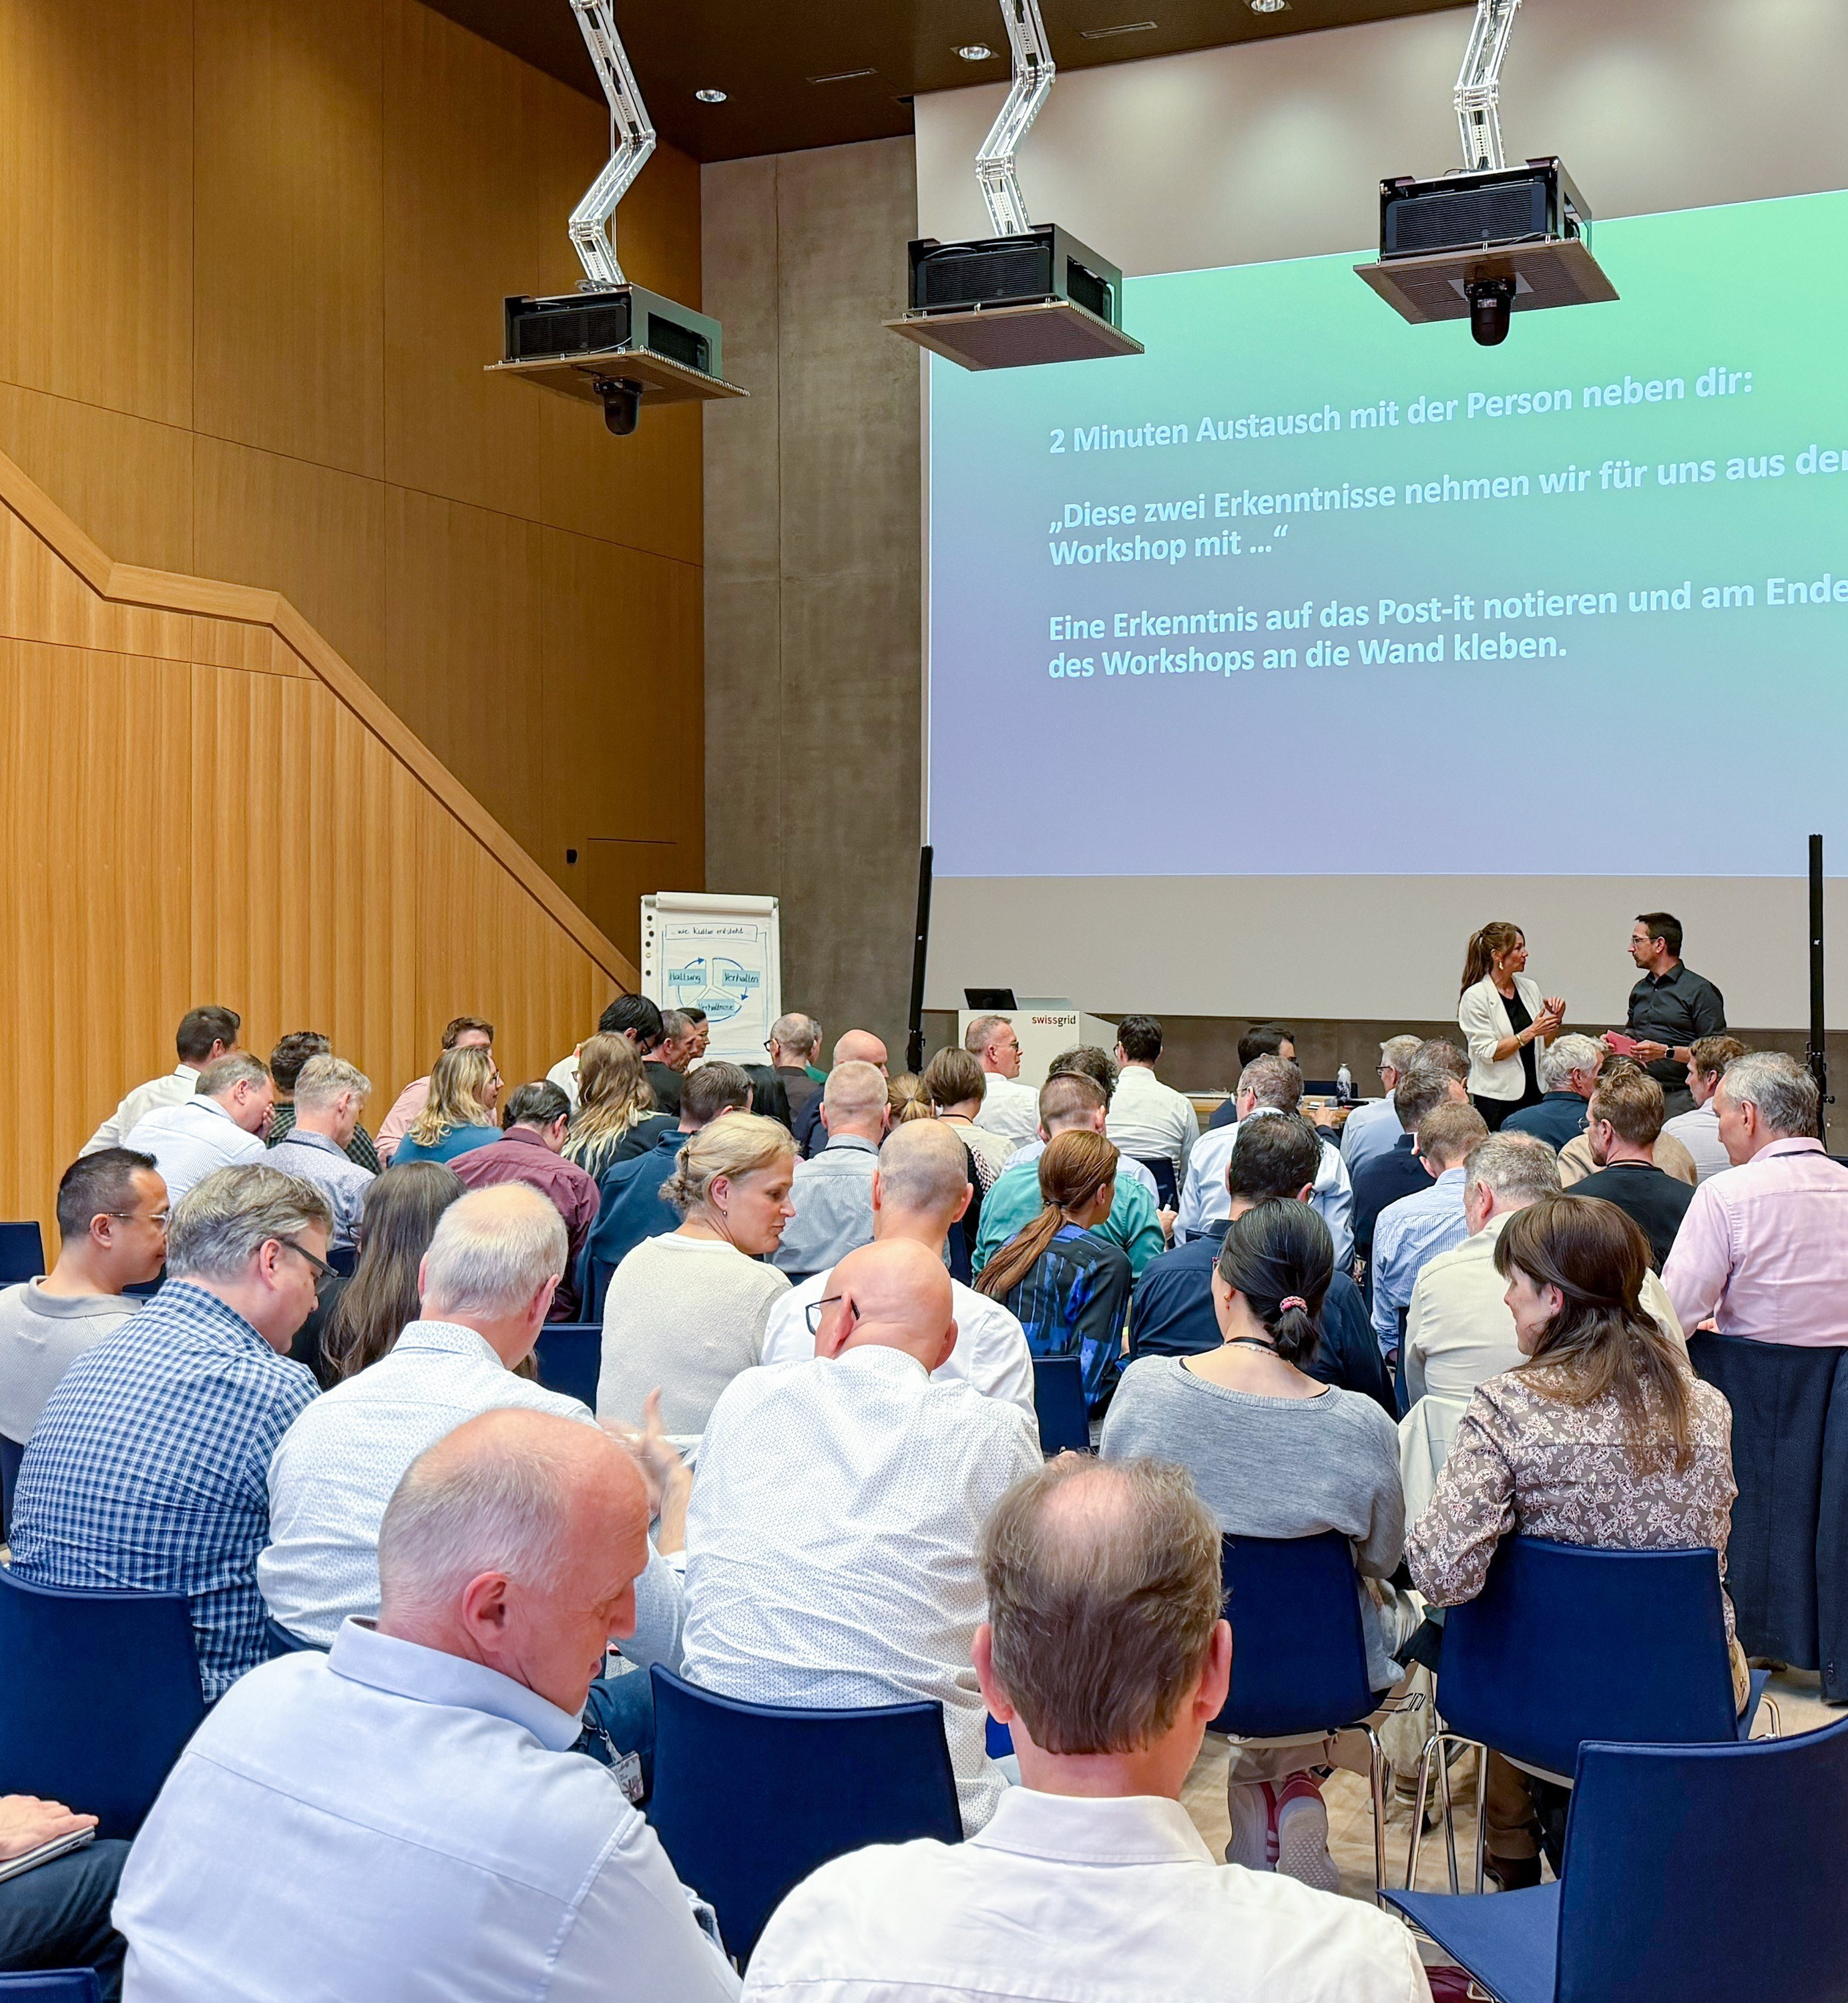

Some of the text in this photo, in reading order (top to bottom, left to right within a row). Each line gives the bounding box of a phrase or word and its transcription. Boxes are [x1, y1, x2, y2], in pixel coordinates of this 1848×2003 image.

[1050, 366, 1753, 454] 2 Minuten Austausch mit der Person neben dir:
[1144, 493, 1206, 523] zwei
[1214, 482, 1396, 517] Erkenntnisse
[1405, 474, 1530, 505] nehmen
[1538, 464, 1592, 494] wir
[1598, 459, 1648, 490] für
[1657, 460, 1716, 485] uns
[1725, 454, 1786, 480] aus
[1049, 534, 1186, 566] Workshop
[1194, 529, 1242, 557] mit
[1050, 573, 1848, 641] Eine Erkenntnis auf das Post-it notieren und am Ende
[1048, 631, 1567, 678] des Workshops an die Wand kleben.
[670, 972, 701, 984] Haltung
[724, 972, 759, 983] Verhalten
[1031, 1015, 1076, 1027] swissgrid
